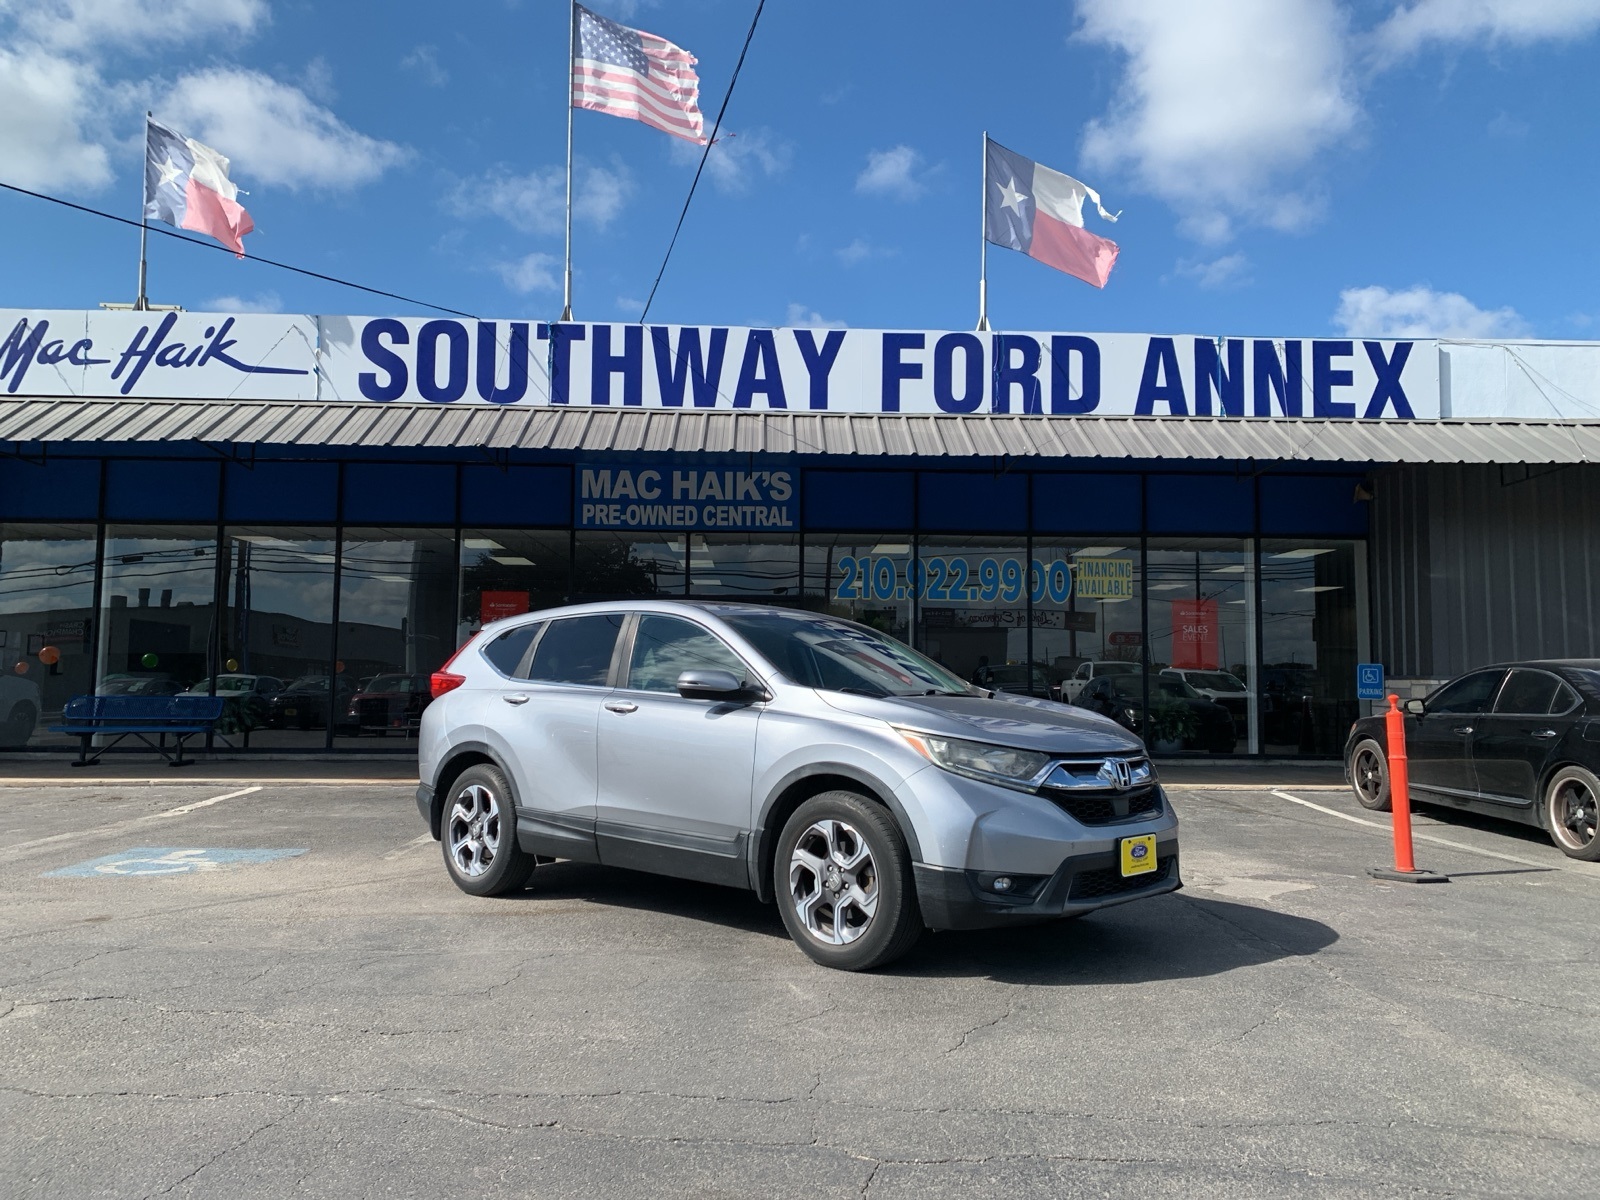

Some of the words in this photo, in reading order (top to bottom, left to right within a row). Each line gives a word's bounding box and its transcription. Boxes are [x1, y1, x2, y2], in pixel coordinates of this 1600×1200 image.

[0, 318, 111, 393] Mac
[111, 312, 309, 395] Haik
[358, 318, 848, 410] SOUTHWAY
[882, 333, 1101, 416] FORD
[1135, 337, 1416, 419] ANNEX
[581, 469, 662, 500] MAC
[672, 470, 793, 501] HAIK'S
[582, 504, 698, 526] PRE-OWNED
[702, 506, 793, 527] CENTRAL
[836, 555, 1072, 604] 210.922.9900
[1077, 561, 1132, 578] FINANCING
[1077, 579, 1132, 595] AVAILABLE
[1182, 624, 1209, 634] SALES
[1182, 633, 1209, 642] EVENT
[1359, 687, 1383, 695] PARKING
